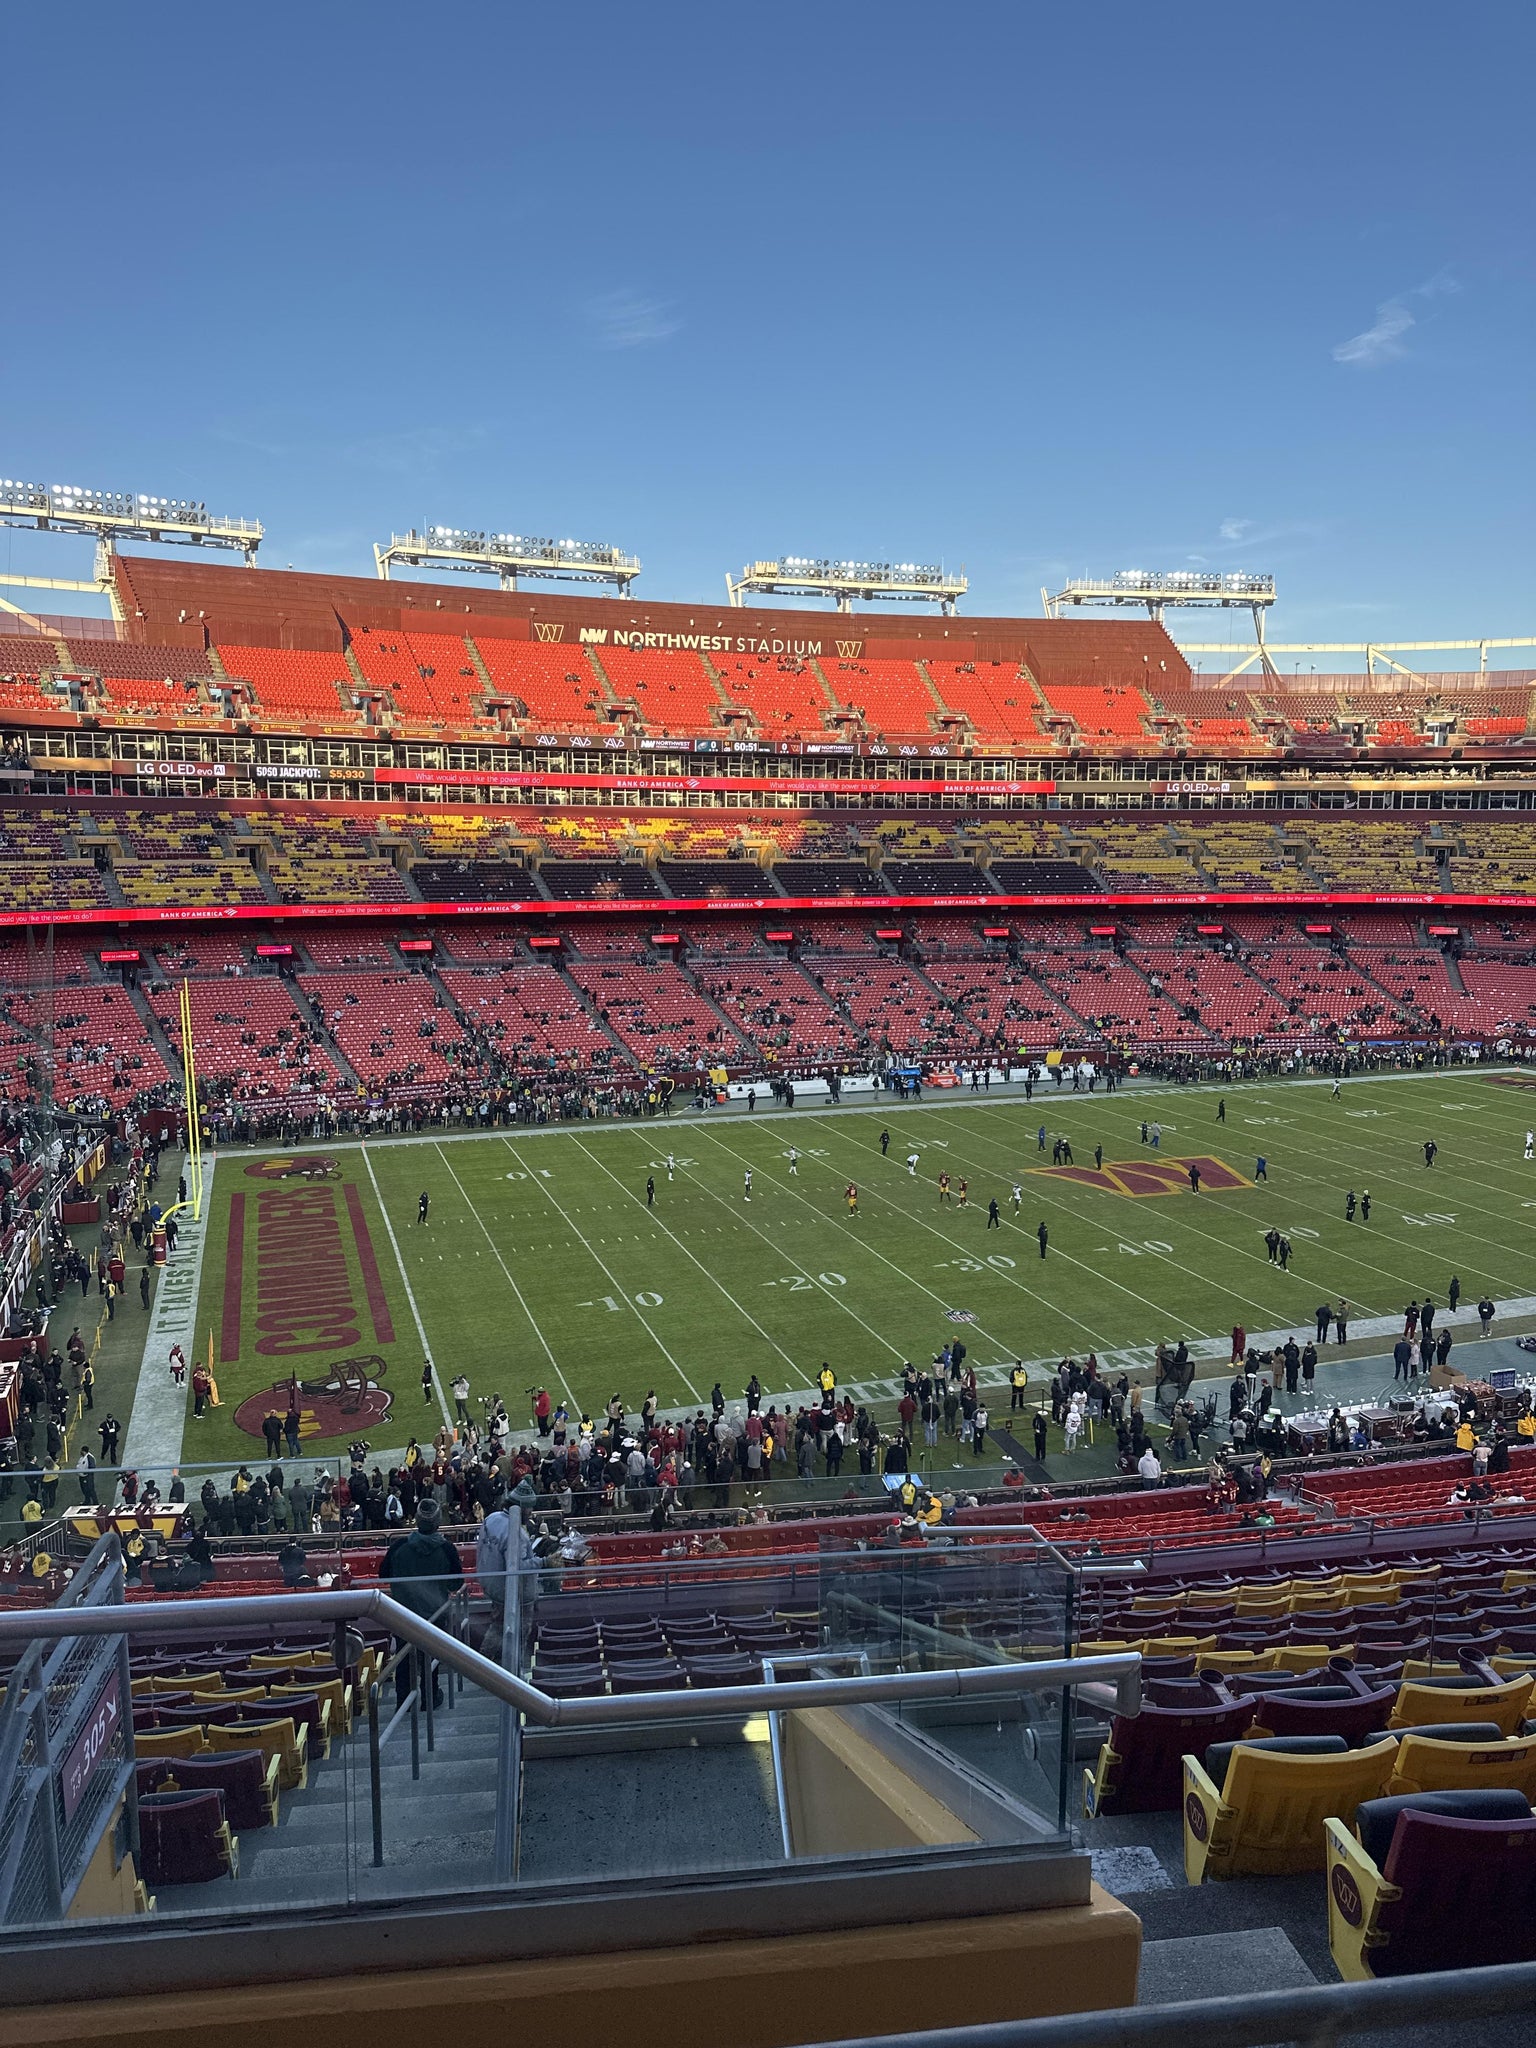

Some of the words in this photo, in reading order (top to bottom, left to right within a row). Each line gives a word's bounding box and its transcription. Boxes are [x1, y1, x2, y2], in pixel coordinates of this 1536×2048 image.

[579, 627, 608, 643] NW
[614, 631, 732, 651] NORTHWEST
[736, 638, 822, 655] STADIUM
[734, 742, 757, 750] 60:51
[136, 763, 154, 774] LG
[159, 763, 195, 775] OLED
[279, 767, 321, 778] JACKPOT:
[329, 769, 365, 780] $5,930
[532, 774, 544, 784] do?
[1167, 783, 1179, 792] LG
[1182, 783, 1208, 792] OLED
[178, 1229, 200, 1242] OF
[170, 1244, 198, 1264] ALL
[1118, 1240, 1174, 1256] 40
[255, 1186, 361, 1356] COMMANDERS
[952, 1255, 1016, 1272] 30
[780, 1272, 848, 1291] 20
[159, 1269, 195, 1315] TAKES
[597, 1291, 664, 1312] 10
[156, 1320, 188, 1334] IT
[83, 1708, 106, 1776] 305
